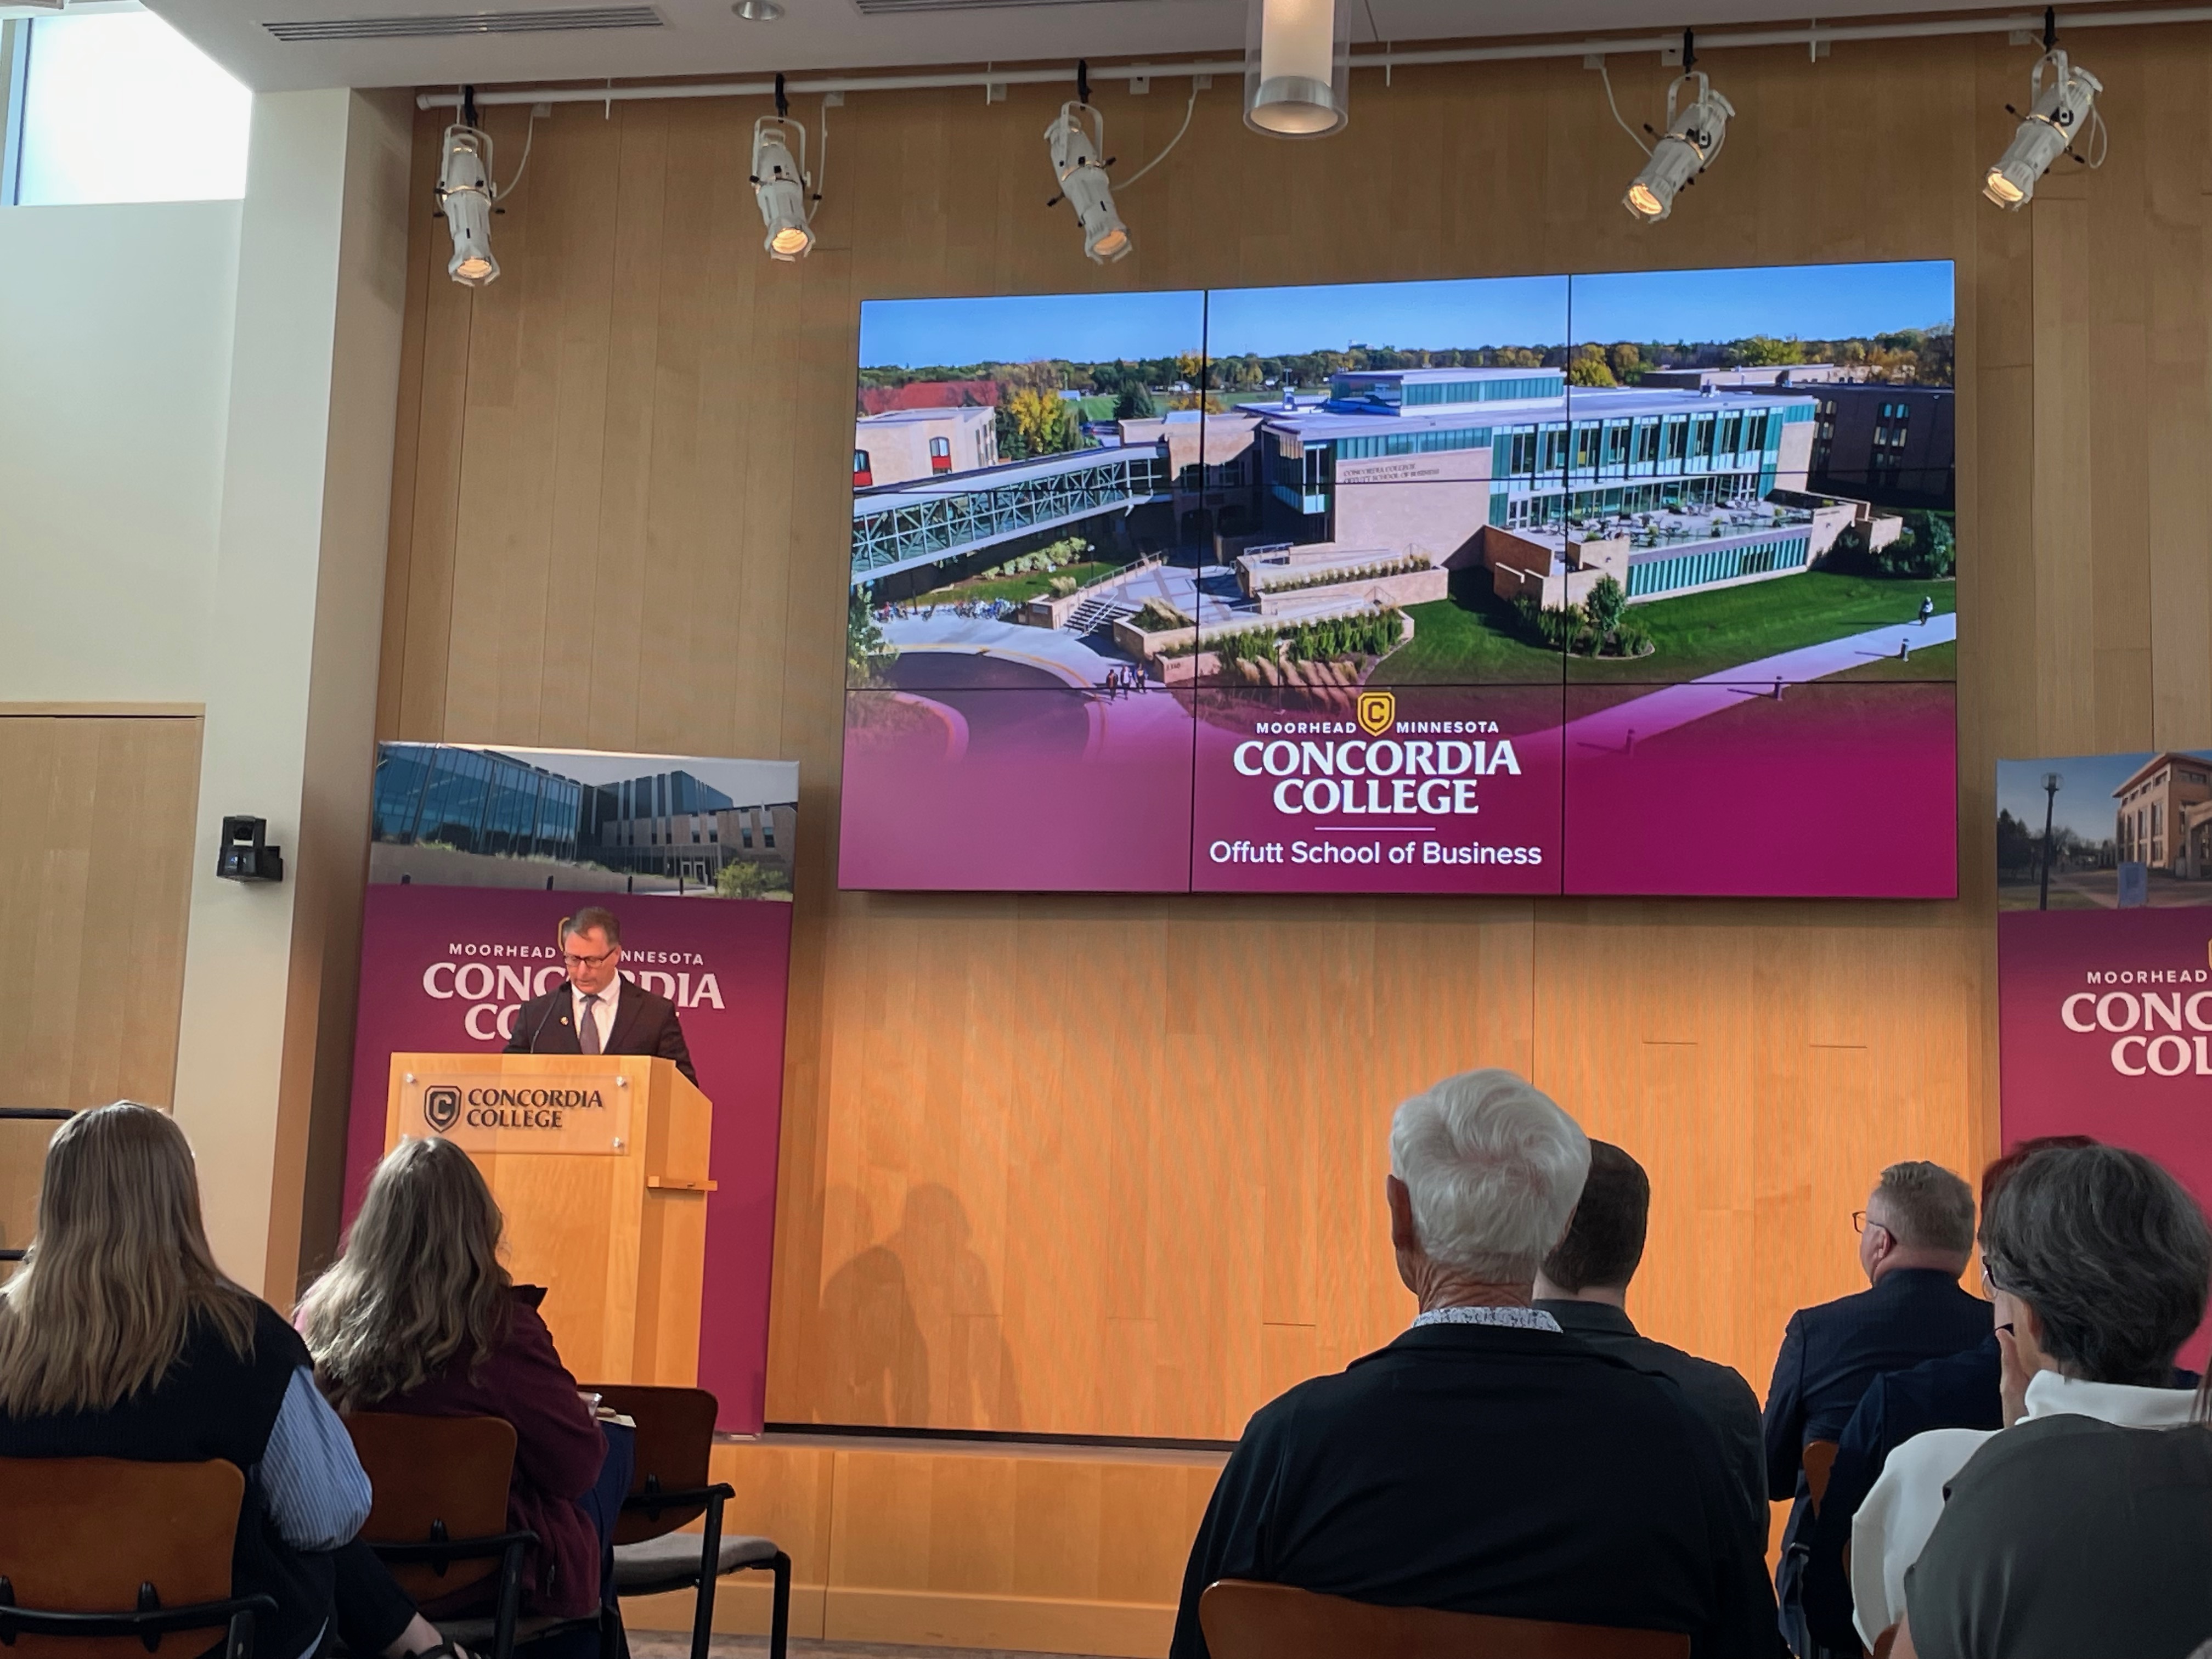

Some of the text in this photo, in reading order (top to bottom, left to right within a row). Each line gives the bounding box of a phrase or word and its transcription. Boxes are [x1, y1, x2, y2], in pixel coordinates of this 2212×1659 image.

[1256, 721, 1499, 734] MOORHEAD MINNESOTA
[1233, 740, 1521, 776] CONCORDIA
[1273, 778, 1479, 814] COLLEGE
[1210, 840, 1542, 865] Offutt School of Business
[449, 943, 704, 966] MOORHEAD NNESOTA
[422, 962, 725, 1009] CONCDIA
[2087, 969, 2208, 984] MOORHEAD
[468, 1088, 603, 1108] CONCORDIA
[467, 1109, 562, 1128] COLLEGE
